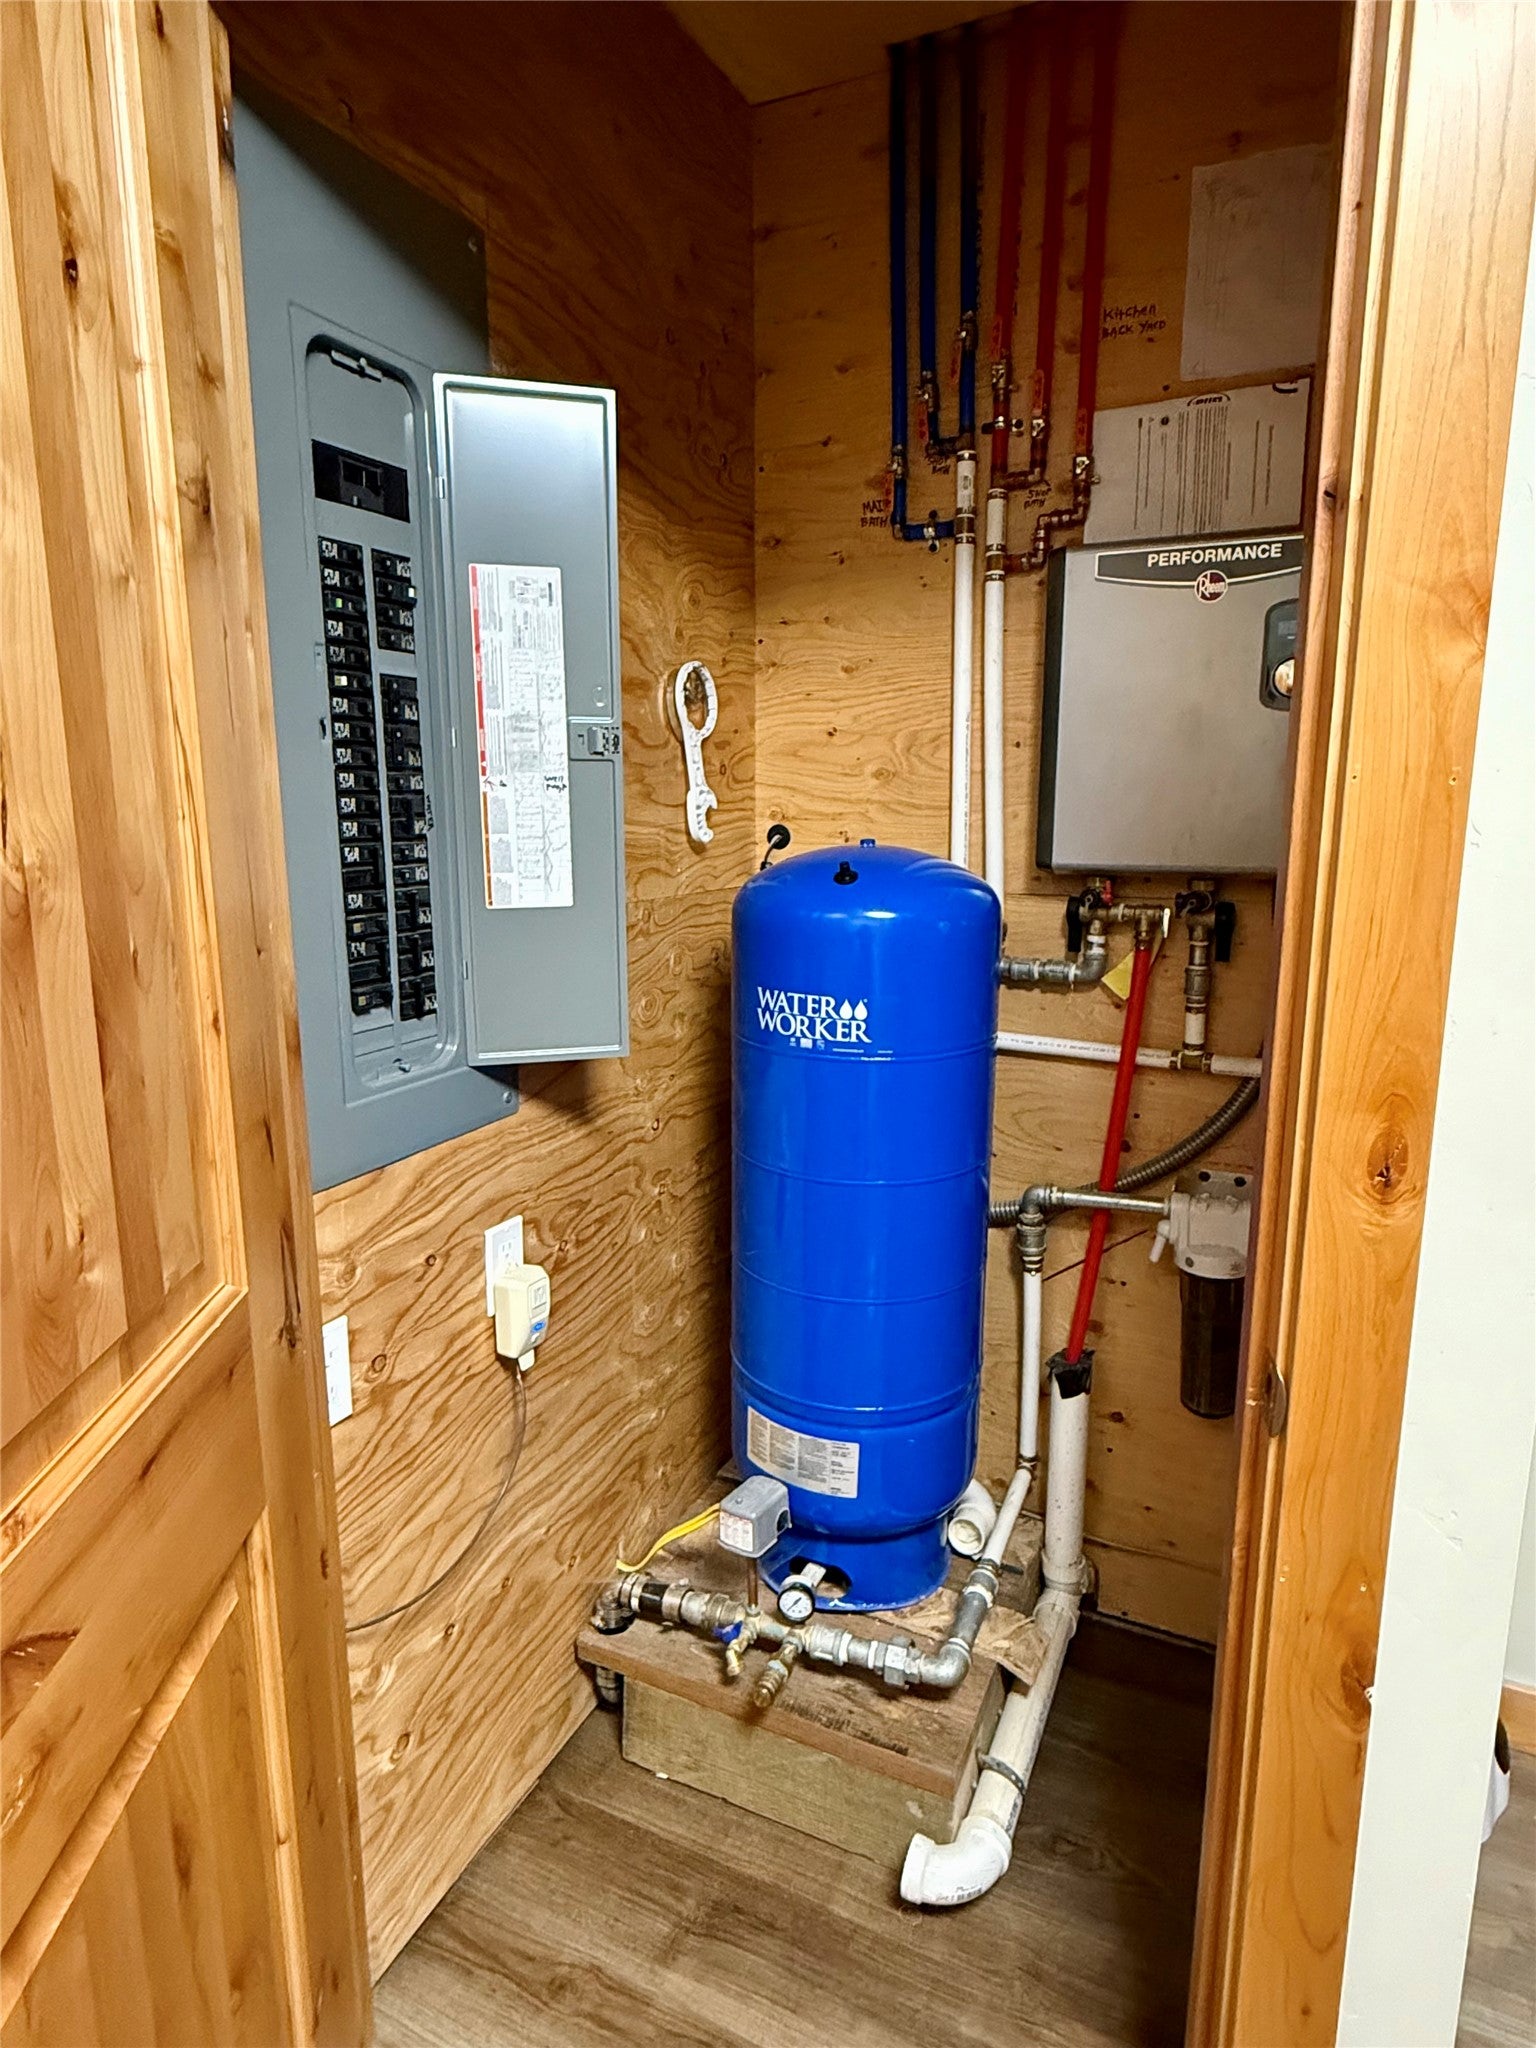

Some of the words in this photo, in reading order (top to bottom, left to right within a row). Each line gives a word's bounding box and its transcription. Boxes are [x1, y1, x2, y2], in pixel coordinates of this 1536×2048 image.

[1102, 325, 1133, 338] BACK
[862, 499, 886, 515] MAI
[861, 516, 888, 528] BATH
[1147, 543, 1283, 568] PERFORMANCE
[757, 986, 840, 1020] WATER
[757, 1007, 873, 1044] WORKER
